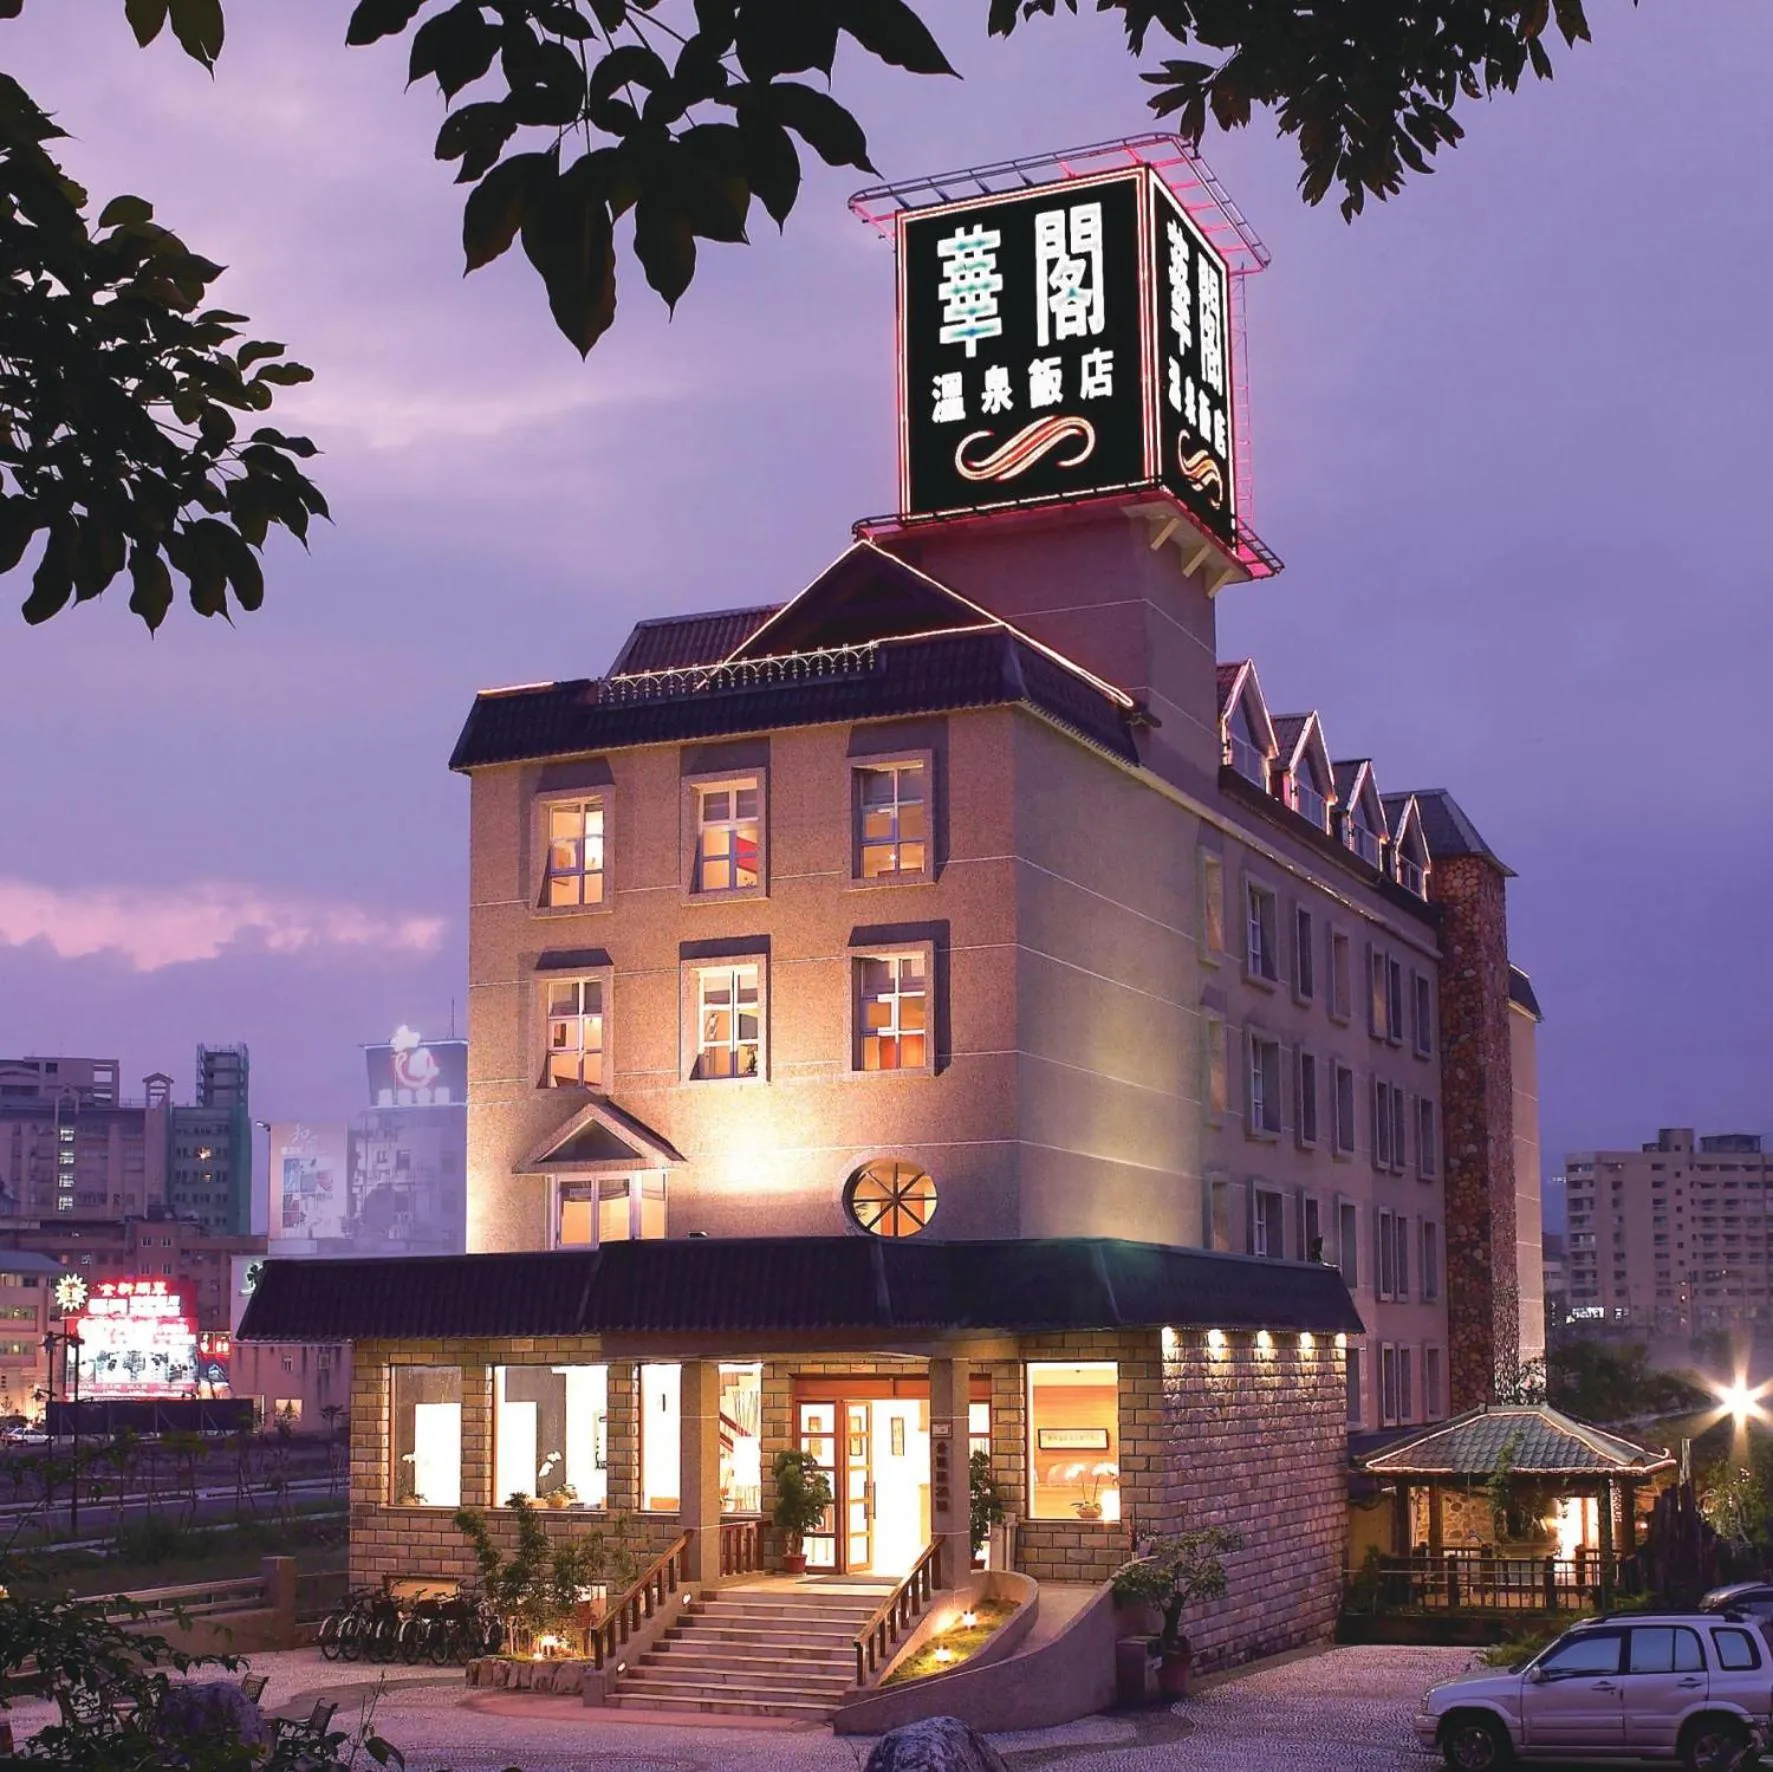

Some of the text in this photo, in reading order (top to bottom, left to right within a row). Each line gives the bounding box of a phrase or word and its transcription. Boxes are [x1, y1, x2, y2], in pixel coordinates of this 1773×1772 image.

[937, 202, 1105, 358] 華閣
[932, 347, 1113, 423] 溫泉飯店
